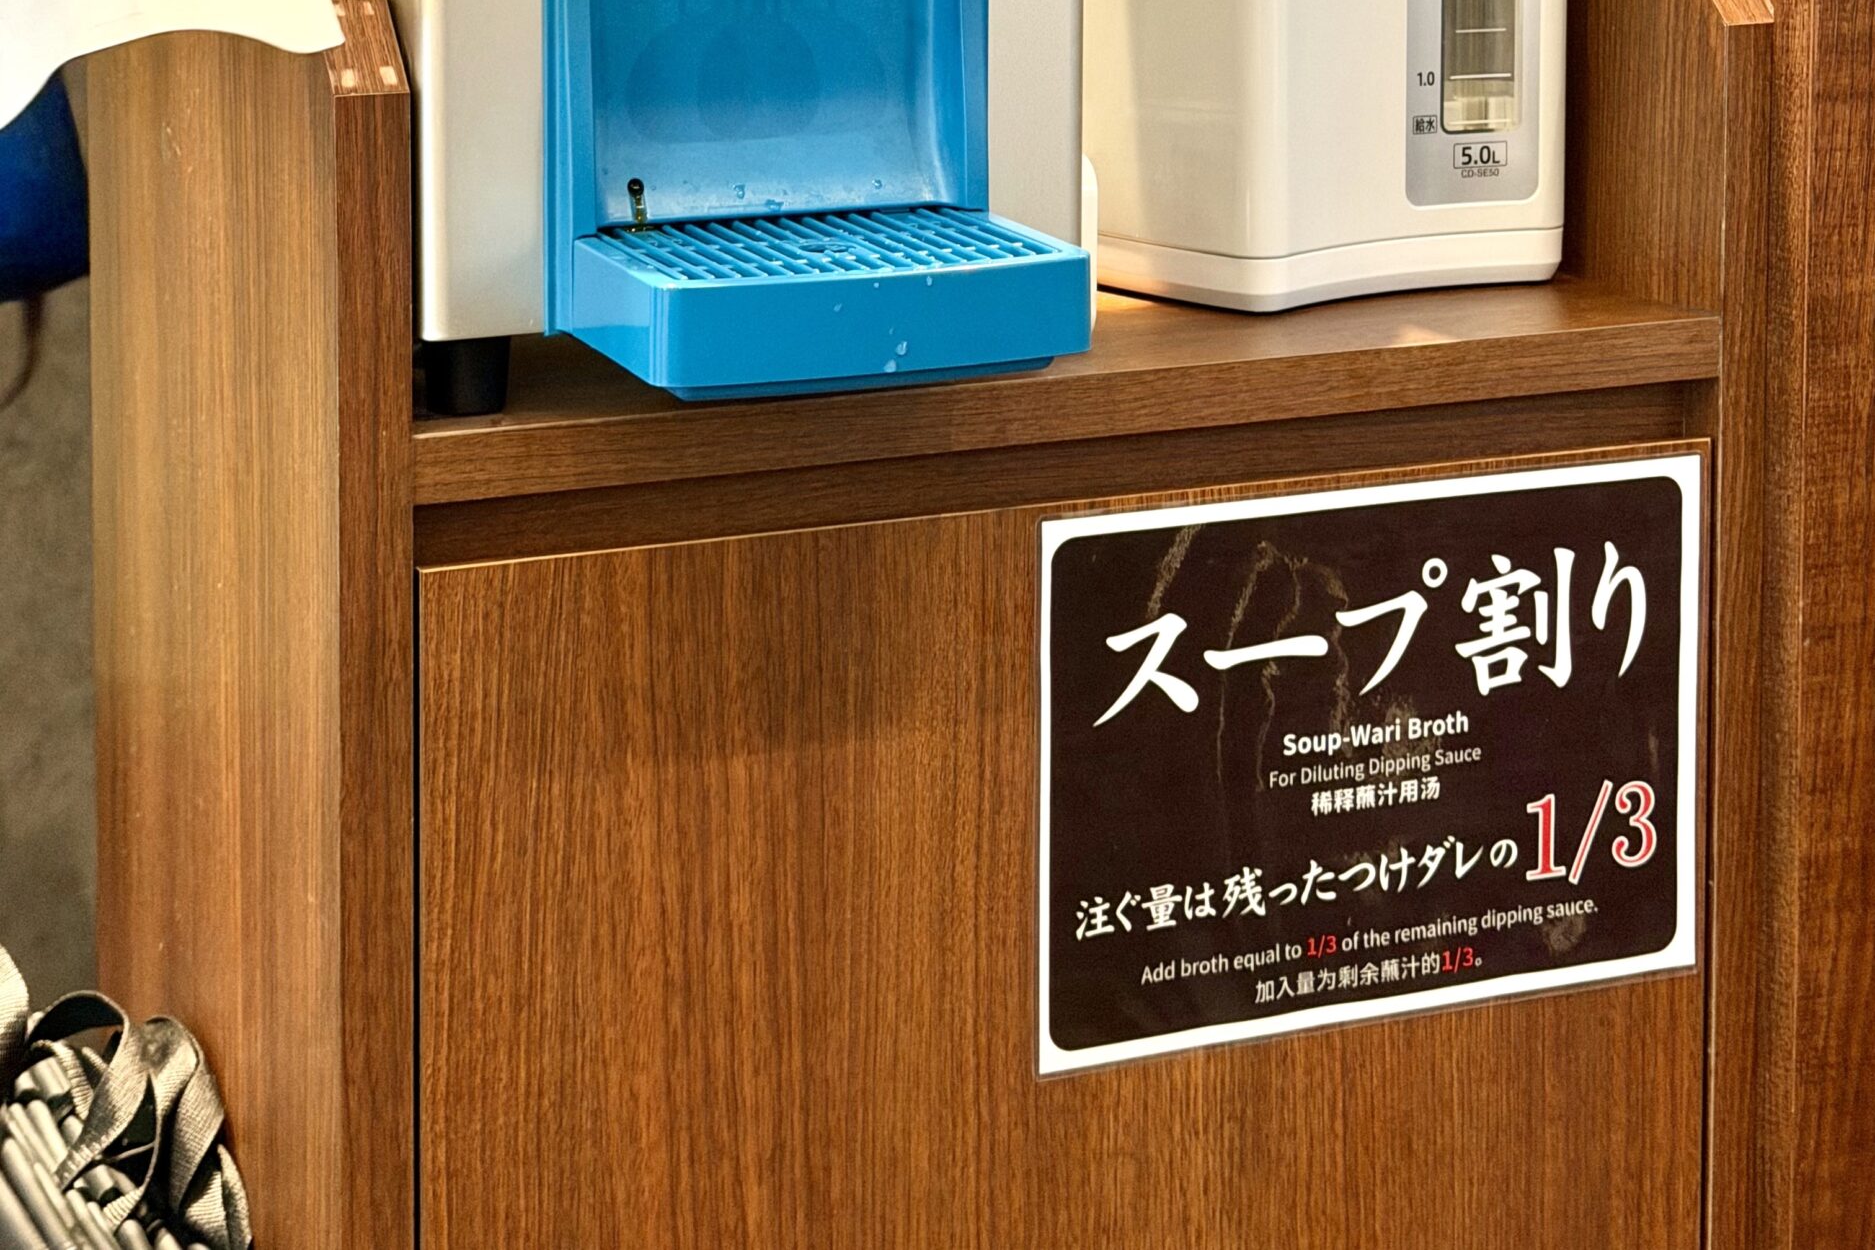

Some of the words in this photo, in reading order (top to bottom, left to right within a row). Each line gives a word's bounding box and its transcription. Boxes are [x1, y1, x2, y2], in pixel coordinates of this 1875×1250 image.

[1417, 71, 1435, 86] 1.0
[1461, 145, 1500, 166] 5.0L
[1093, 541, 1647, 727] スープ割り
[1282, 718, 1401, 756] Soup-Wari
[1407, 710, 1469, 740] Broth
[1269, 771, 1296, 788] For
[1300, 762, 1365, 784] Diluting
[1368, 752, 1431, 777] Dipping
[1434, 746, 1482, 767] Sauce
[1310, 775, 1441, 816] 稀释蘸汁用汤
[1141, 960, 1175, 986] Add
[1180, 951, 1229, 978] broth
[1233, 942, 1280, 971] equal
[1285, 943, 1302, 961] to
[1307, 934, 1337, 959] 1/3
[1341, 930, 1359, 952] of
[1363, 927, 1390, 949] the
[1394, 914, 1478, 945] remaining
[1481, 904, 1543, 931] dipping
[1546, 898, 1599, 919] sauce.
